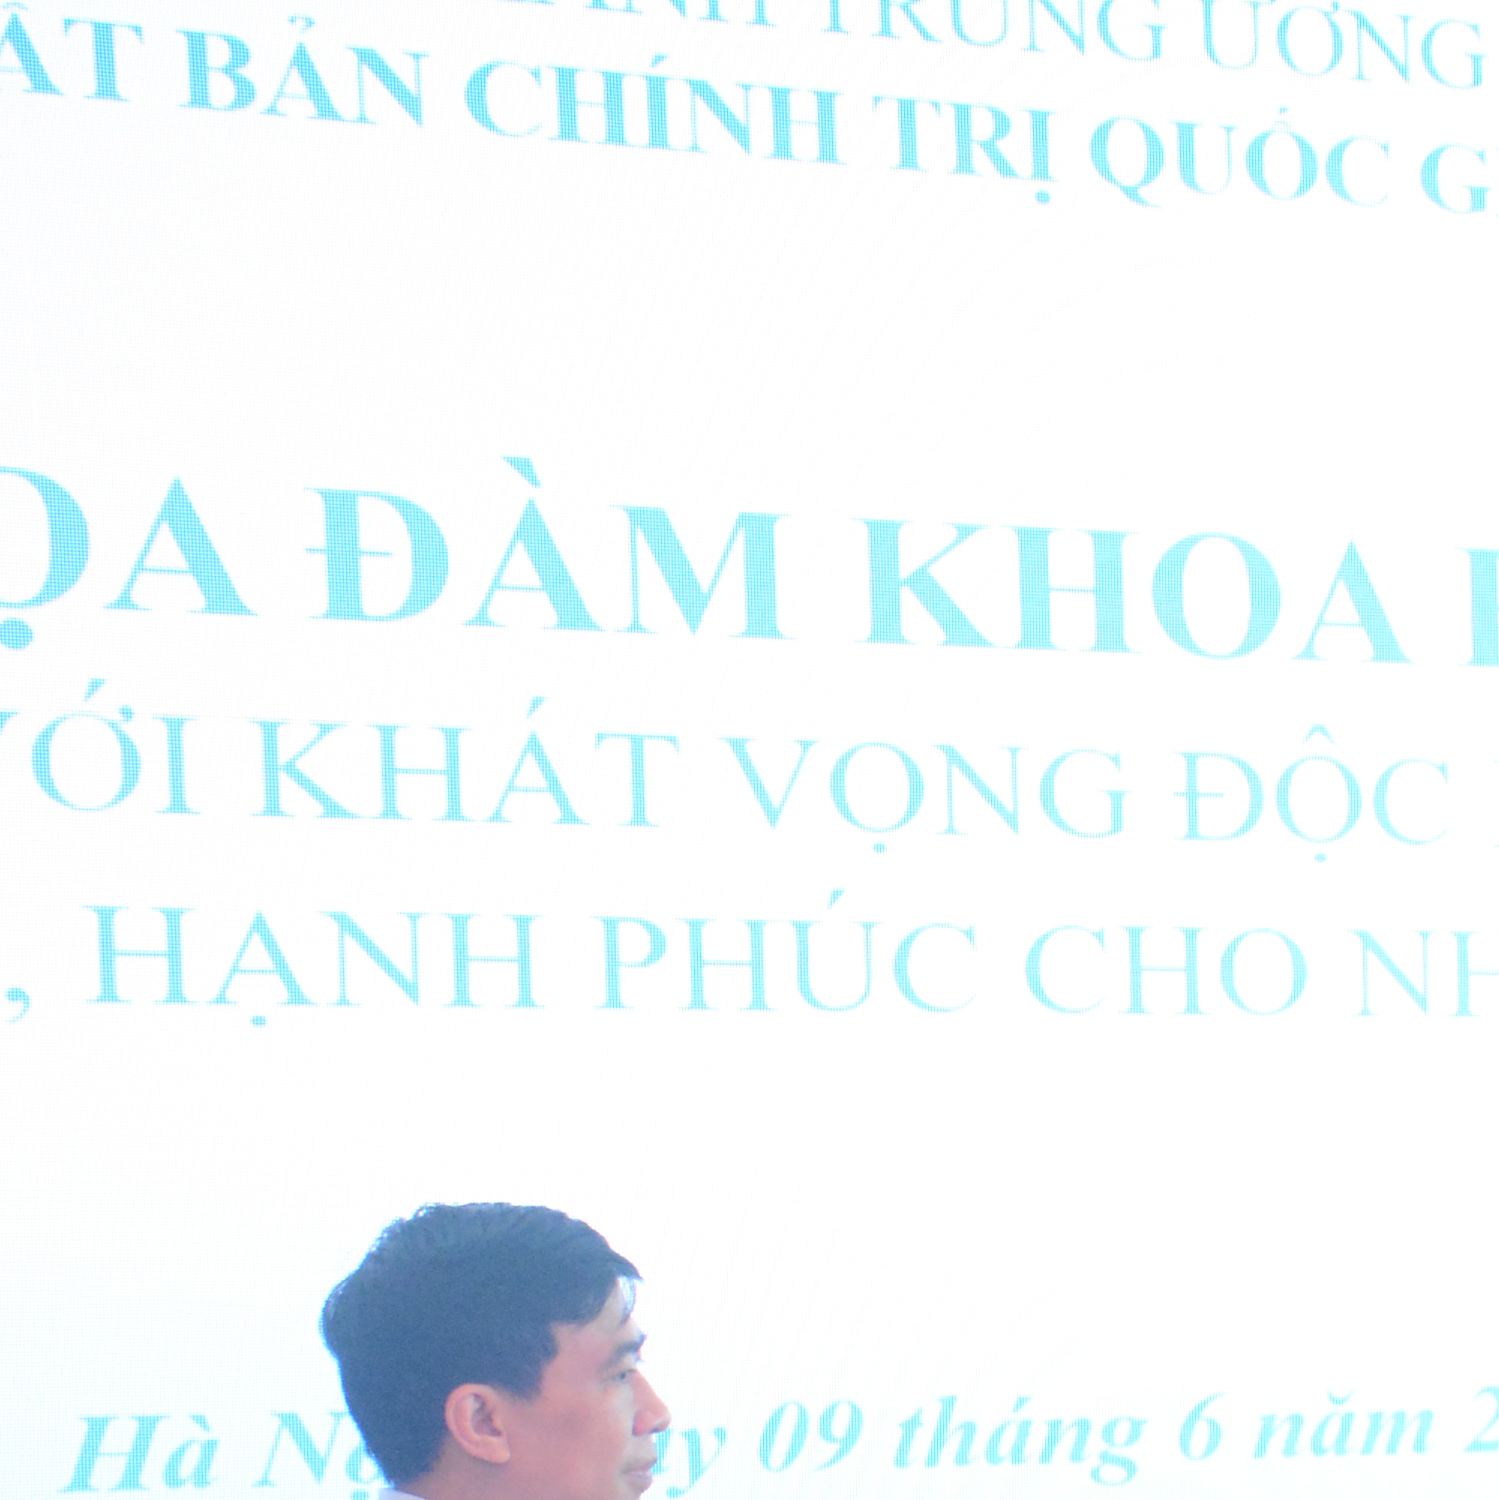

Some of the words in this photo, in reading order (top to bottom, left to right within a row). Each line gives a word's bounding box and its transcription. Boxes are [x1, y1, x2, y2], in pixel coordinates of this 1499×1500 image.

[174, 12, 430, 128] BẢN
[463, 50, 846, 166] CHÍNH
[872, 93, 1059, 206] TRỊ
[1089, 104, 1391, 208] QUỐC
[1200, 0, 1487, 90] ƯƠNG
[303, 454, 794, 641] ĐÀM
[852, 517, 1413, 664] KHOA
[0, 676, 202, 816] ỚI
[247, 695, 681, 828] KHÁT
[718, 735, 1130, 855] VỌNG
[1173, 723, 1449, 863] ĐỘC
[81, 904, 546, 1029] HẠNH
[592, 887, 977, 1014] PHÚC
[1023, 924, 1309, 1016] CHO
[59, 1412, 219, 1493] Hà
[758, 1399, 864, 1472] 09
[893, 1395, 1148, 1486] tháng
[1178, 1391, 1226, 1462] 6
[1252, 1389, 1435, 1460] năm
